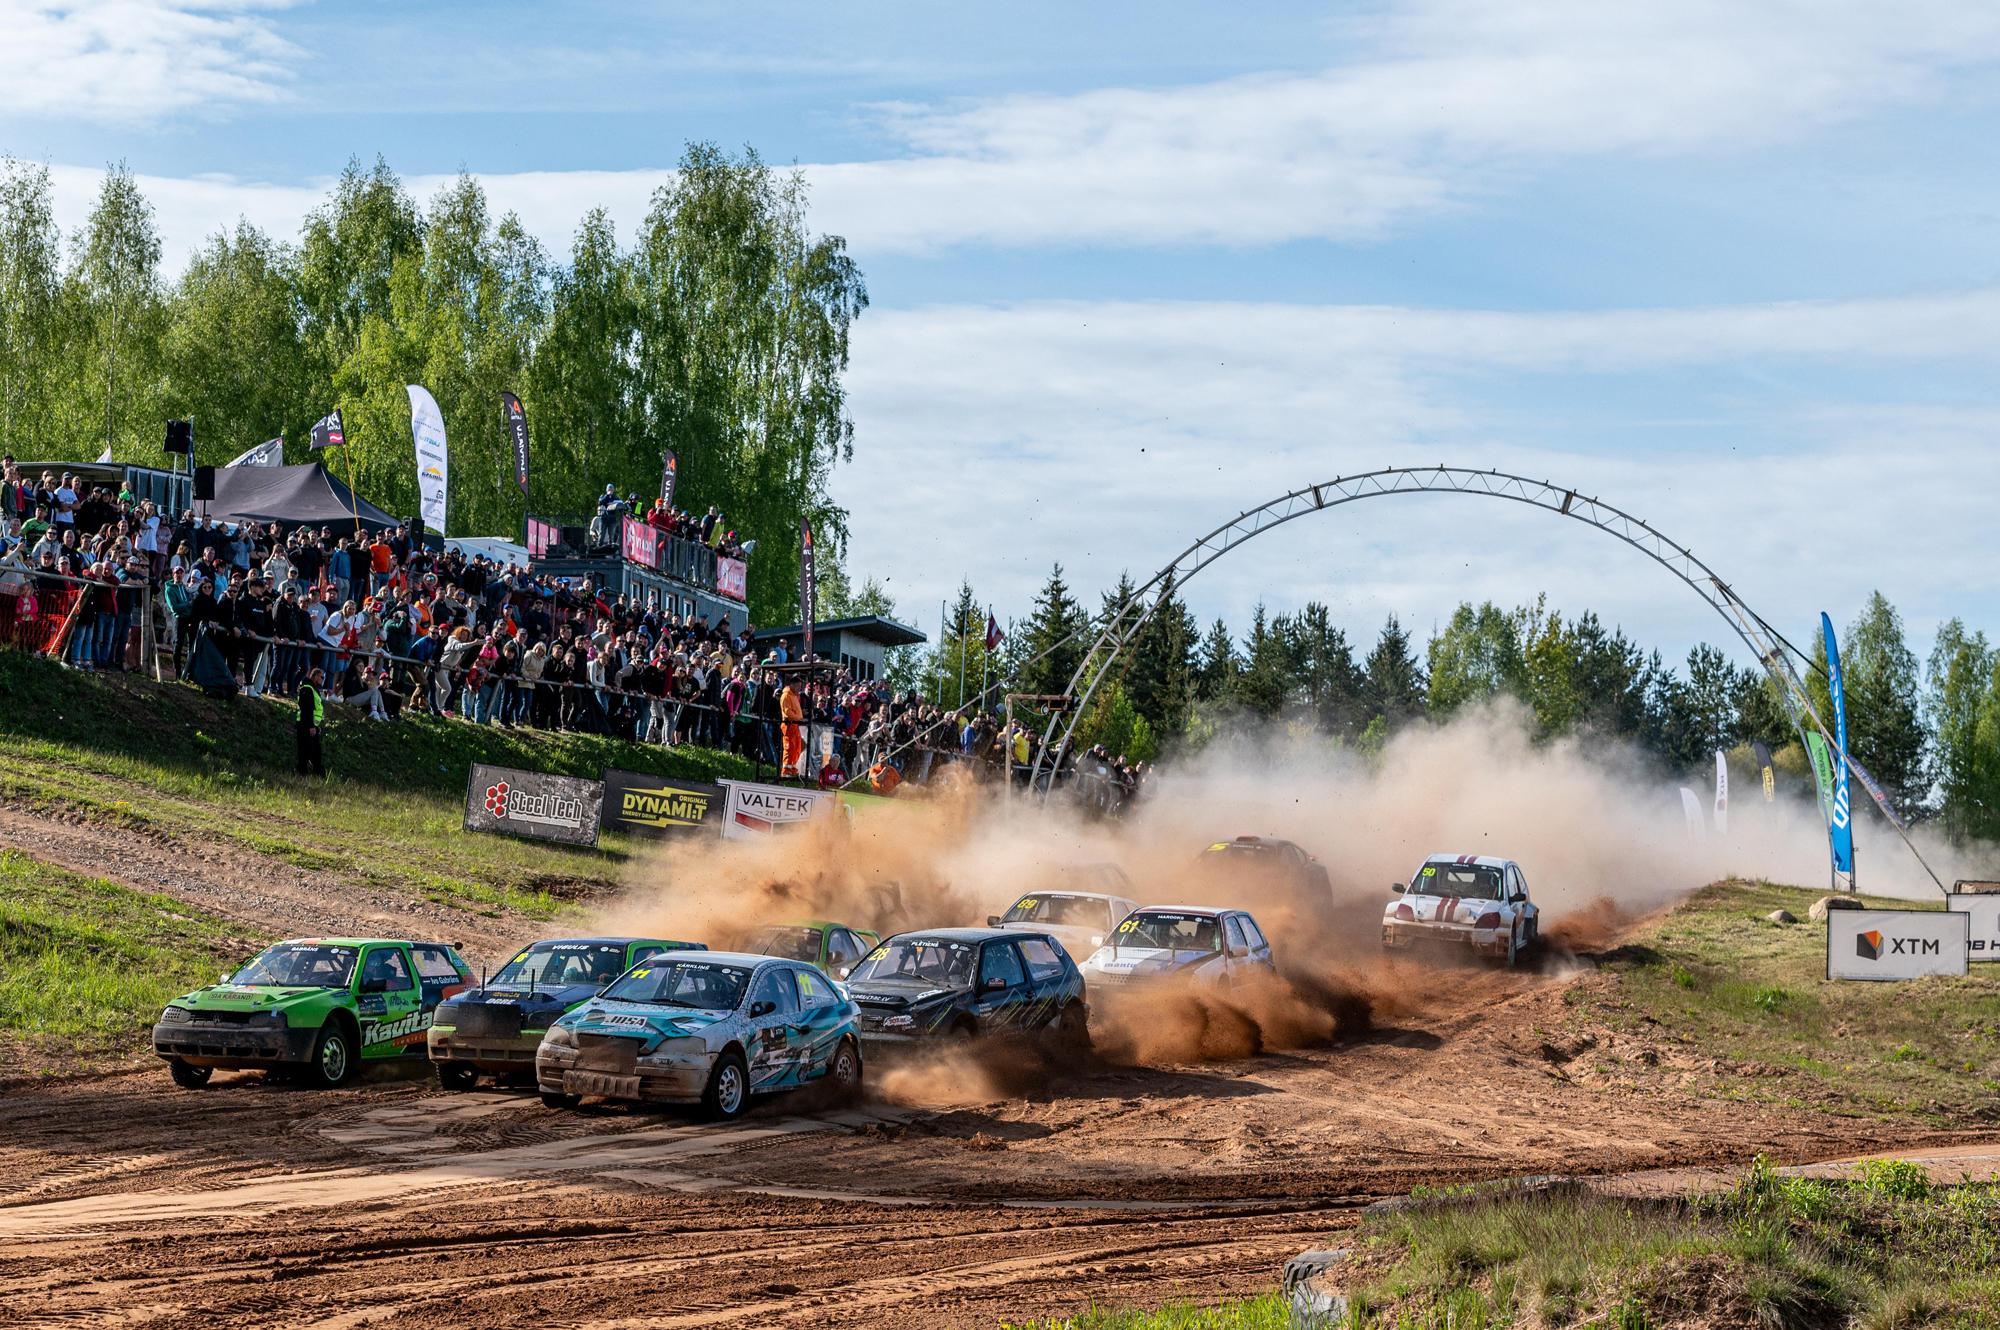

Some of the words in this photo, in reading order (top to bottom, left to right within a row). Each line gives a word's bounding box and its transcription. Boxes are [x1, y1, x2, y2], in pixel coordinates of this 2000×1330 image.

[510, 790, 549, 816] Steel
[551, 795, 582, 819] Tech
[678, 795, 708, 806] ORIGINAL
[741, 792, 809, 813] VALTEK
[621, 809, 642, 818] ENERGY
[641, 811, 657, 820] DRINK
[765, 810, 782, 818] 2003
[1207, 842, 1230, 851] 5
[1422, 867, 1436, 877] 50
[1017, 898, 1038, 909] 89
[1119, 920, 1139, 933] 61
[1891, 938, 1940, 955] XTM
[867, 948, 891, 961] 28
[631, 969, 651, 979] 11
[430, 977, 439, 985] Ivo
[799, 973, 814, 995] 11
[364, 1012, 433, 1047] Kavita
